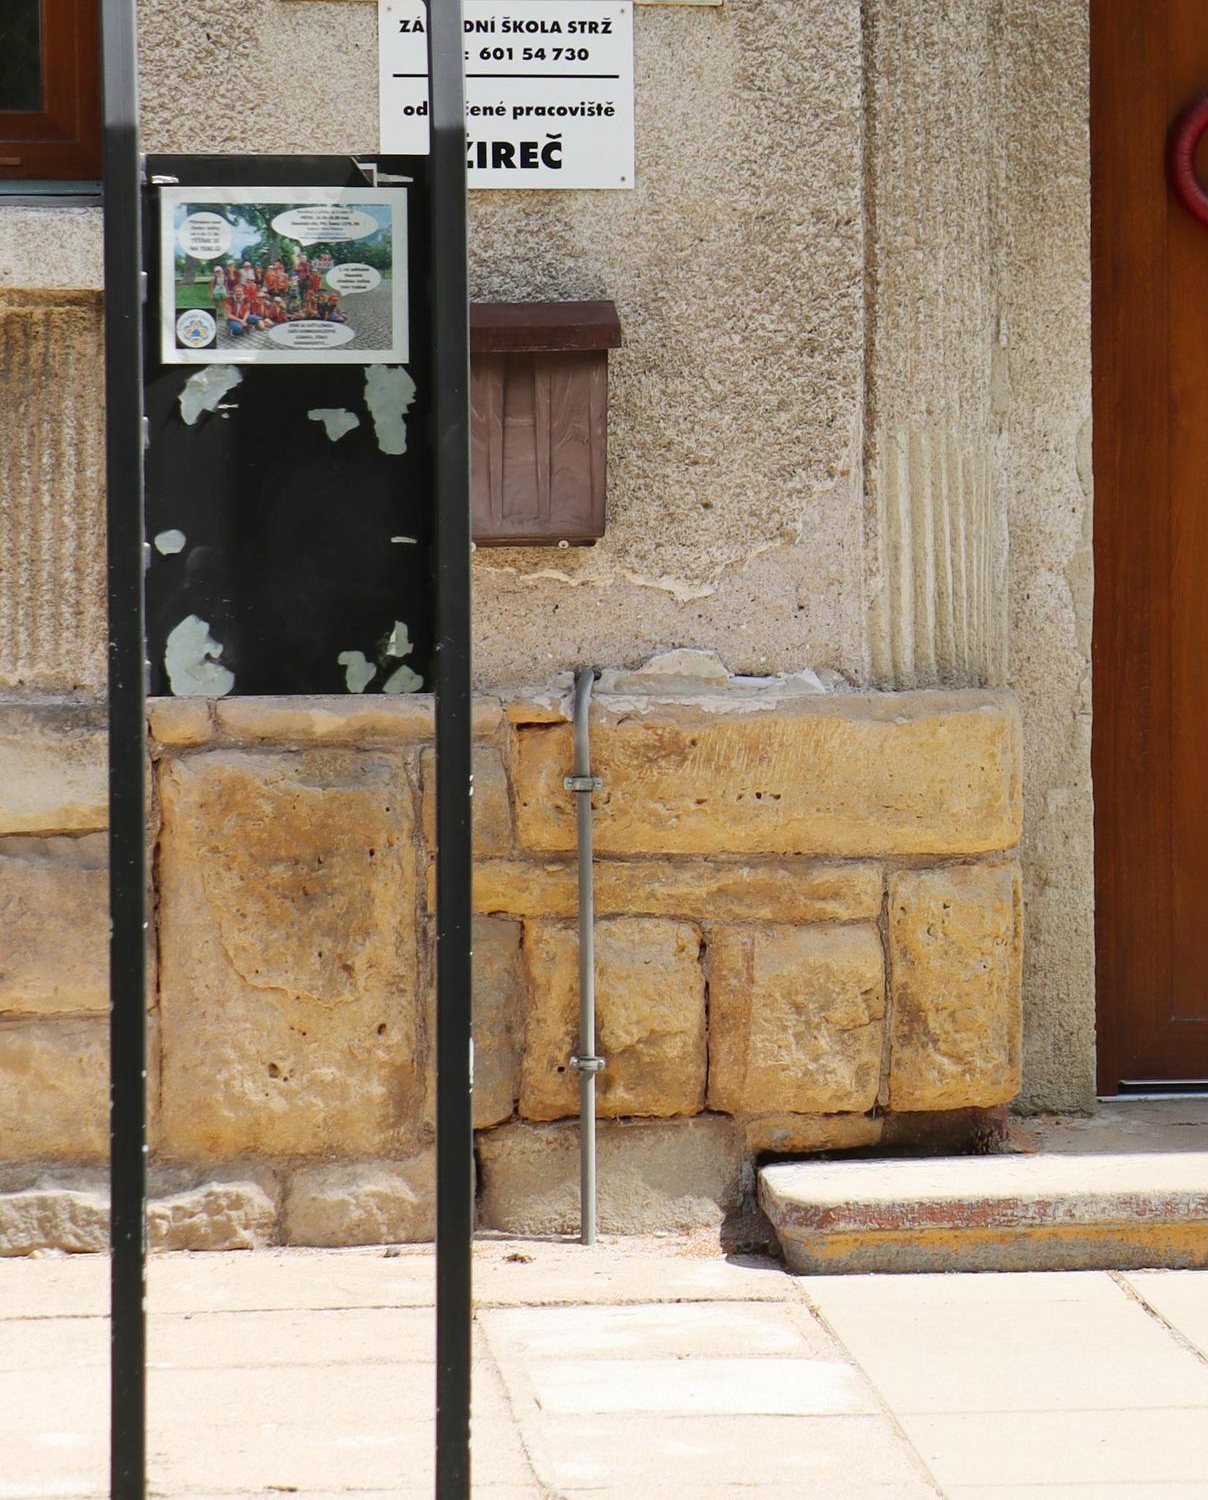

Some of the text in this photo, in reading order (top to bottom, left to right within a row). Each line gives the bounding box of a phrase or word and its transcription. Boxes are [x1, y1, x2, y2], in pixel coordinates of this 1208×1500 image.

[399, 16, 612, 34] ZÁDNÍ ŠKOLA STRŽ
[479, 48, 514, 61] 601
[522, 48, 546, 61] 54
[552, 48, 589, 61] 730
[512, 101, 615, 120] pracoviště
